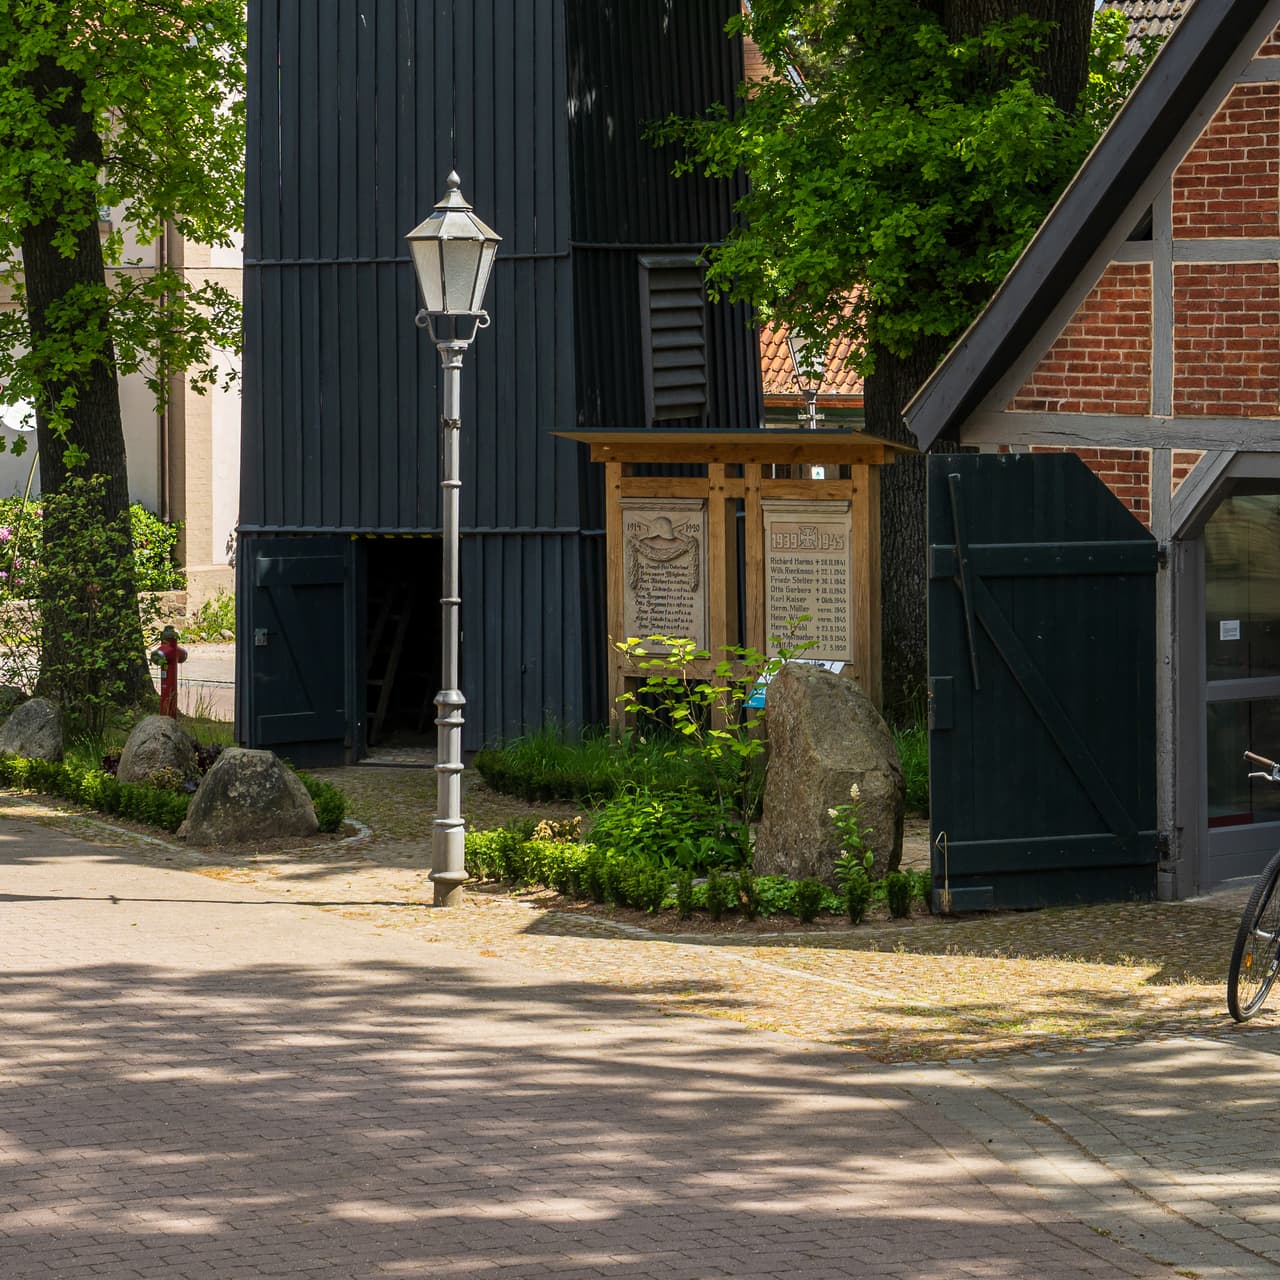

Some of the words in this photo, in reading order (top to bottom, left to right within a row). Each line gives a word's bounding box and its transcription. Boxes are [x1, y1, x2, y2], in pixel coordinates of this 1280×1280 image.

[627, 522, 641, 532] 1914
[772, 533, 798, 549] 1939
[820, 534, 845, 550] 1945
[770, 557, 792, 565] Richard
[794, 557, 814, 565] Harms
[771, 585, 784, 593] Otto
